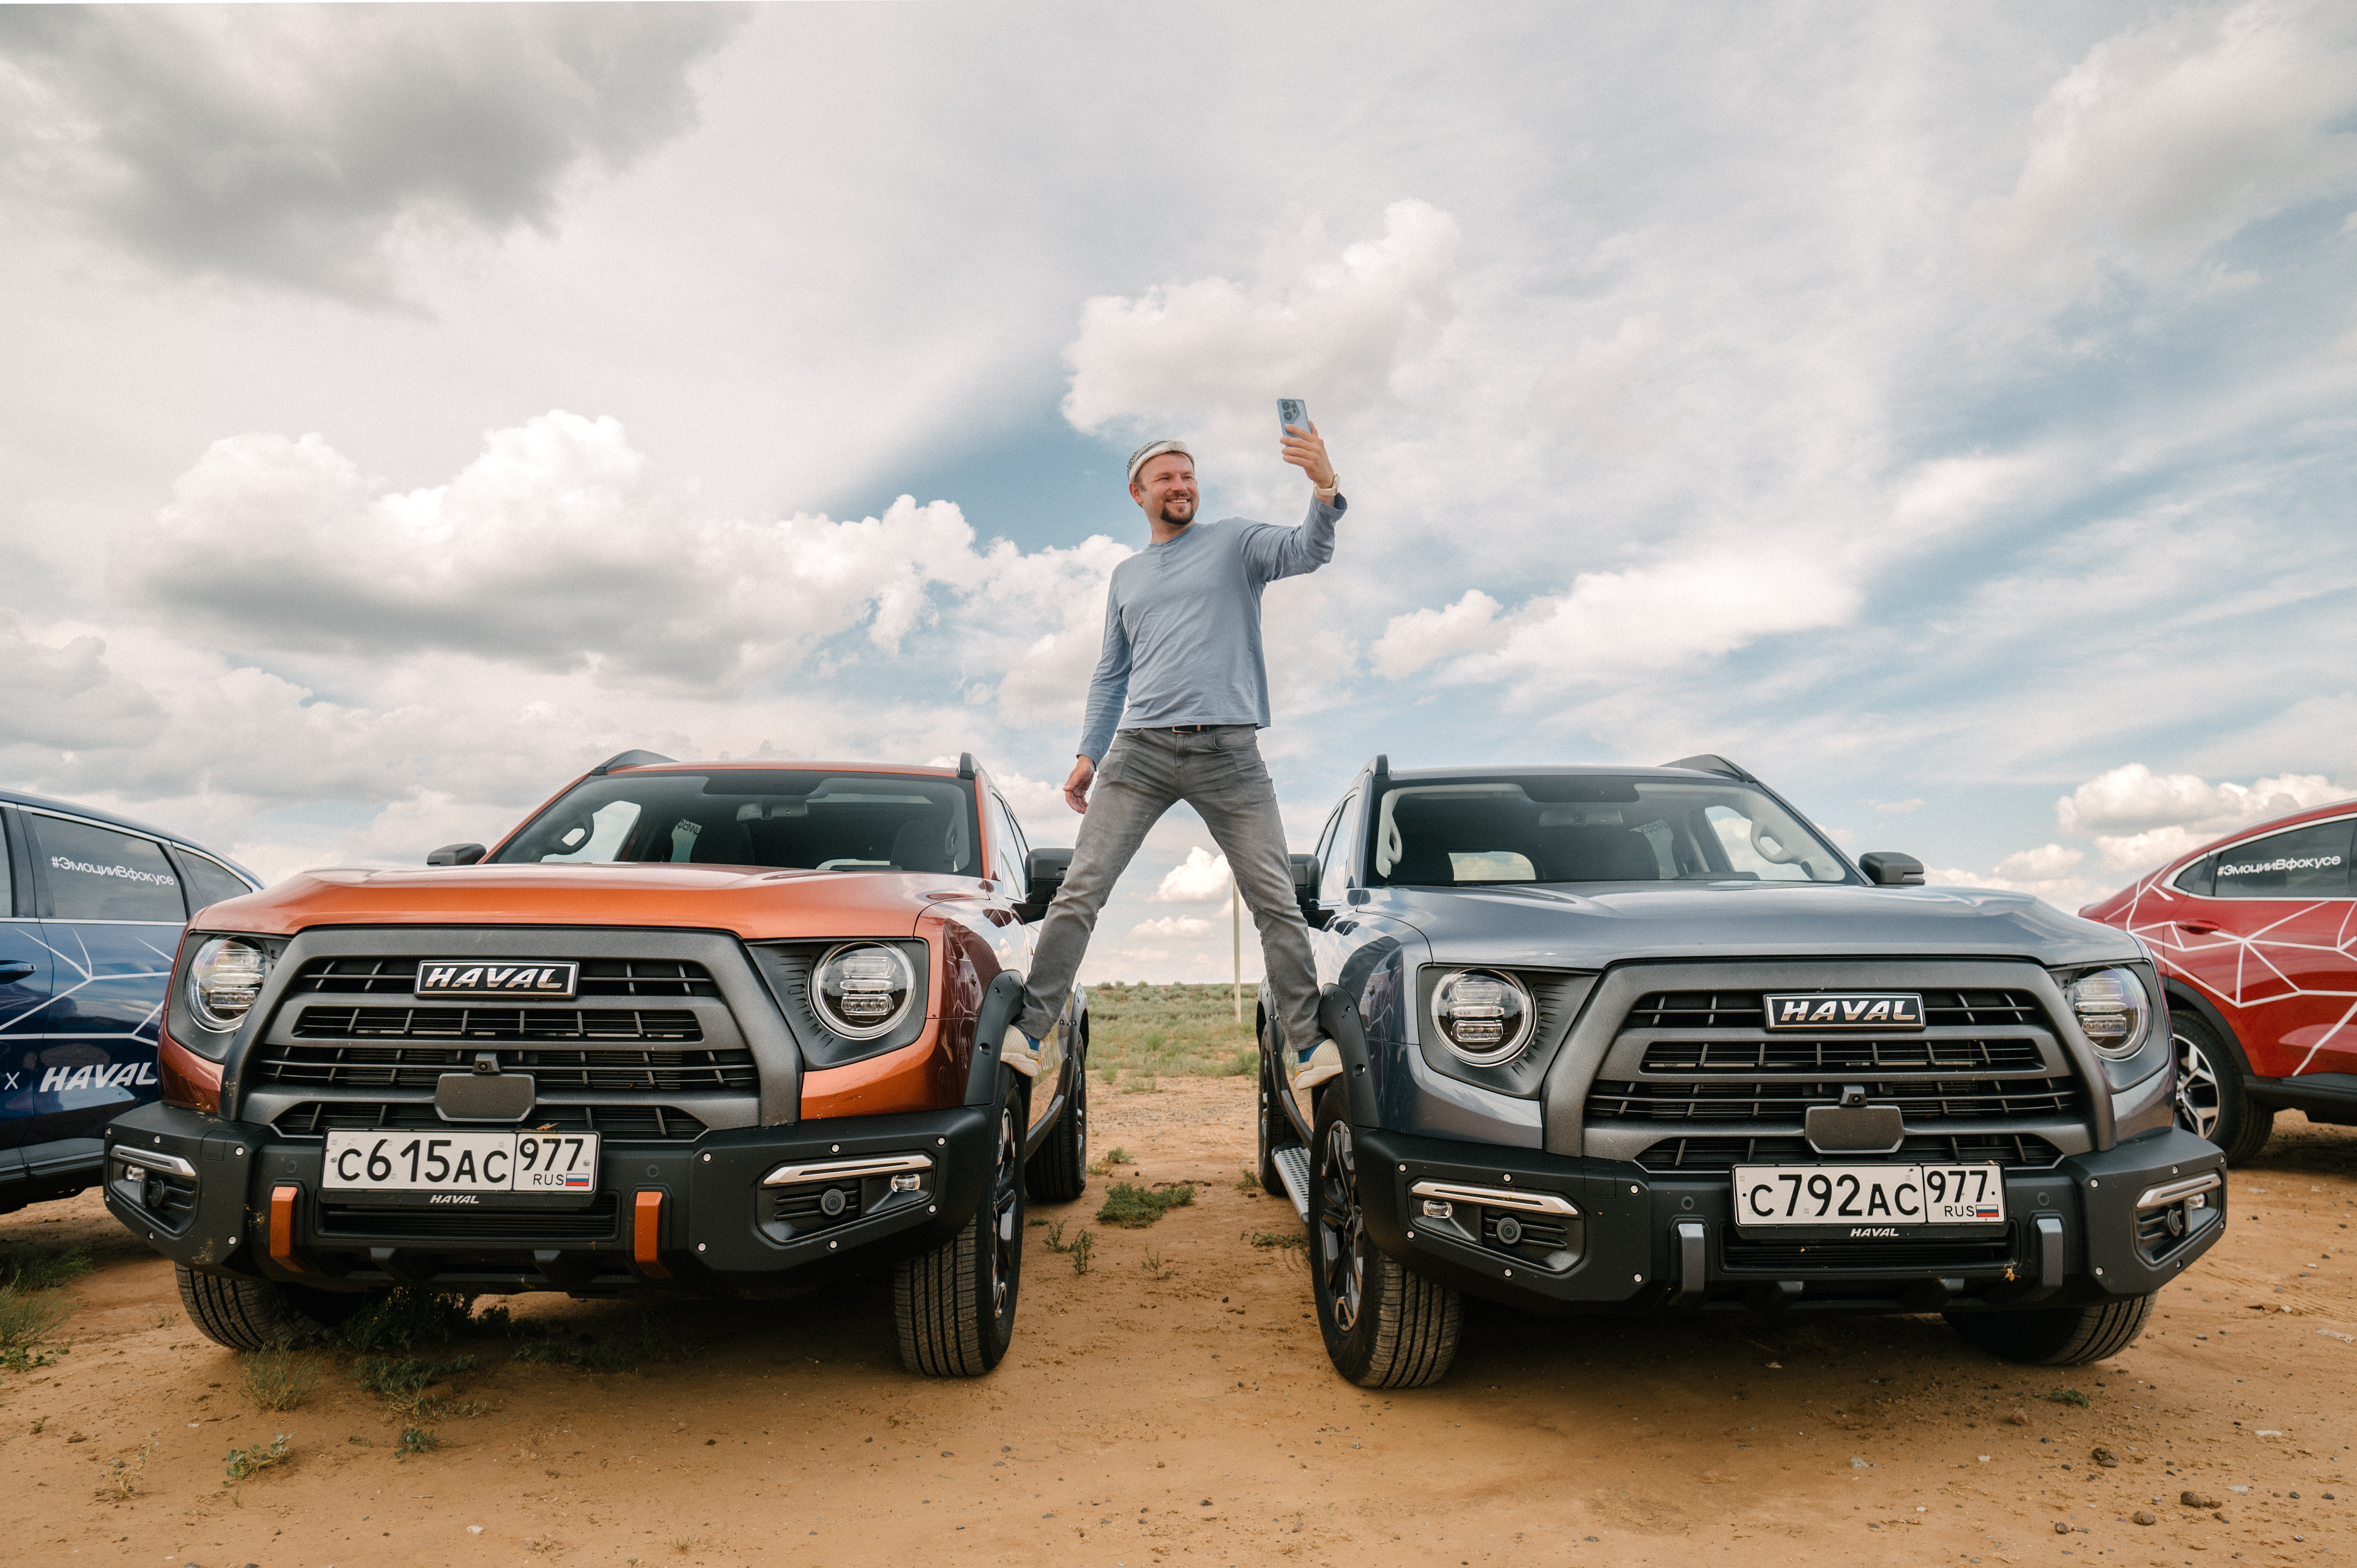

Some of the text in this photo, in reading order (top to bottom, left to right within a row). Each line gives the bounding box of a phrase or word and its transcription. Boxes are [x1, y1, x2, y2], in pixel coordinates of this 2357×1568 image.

[51, 856, 174, 885] #ЭмоцииВфокусе
[2217, 855, 2341, 876] #ЭмоцииВфокусе
[425, 968, 562, 988] HAVAL
[1781, 1001, 1916, 1021] HAVAL
[39, 1062, 158, 1092] HAVAL
[519, 1137, 584, 1171] 977
[533, 1174, 564, 1185] RUS
[1926, 1170, 1988, 1203] 977
[429, 1195, 479, 1204] HAVAL
[1944, 1205, 1974, 1217] RUS
[1850, 1228, 1899, 1237] HAVAL
